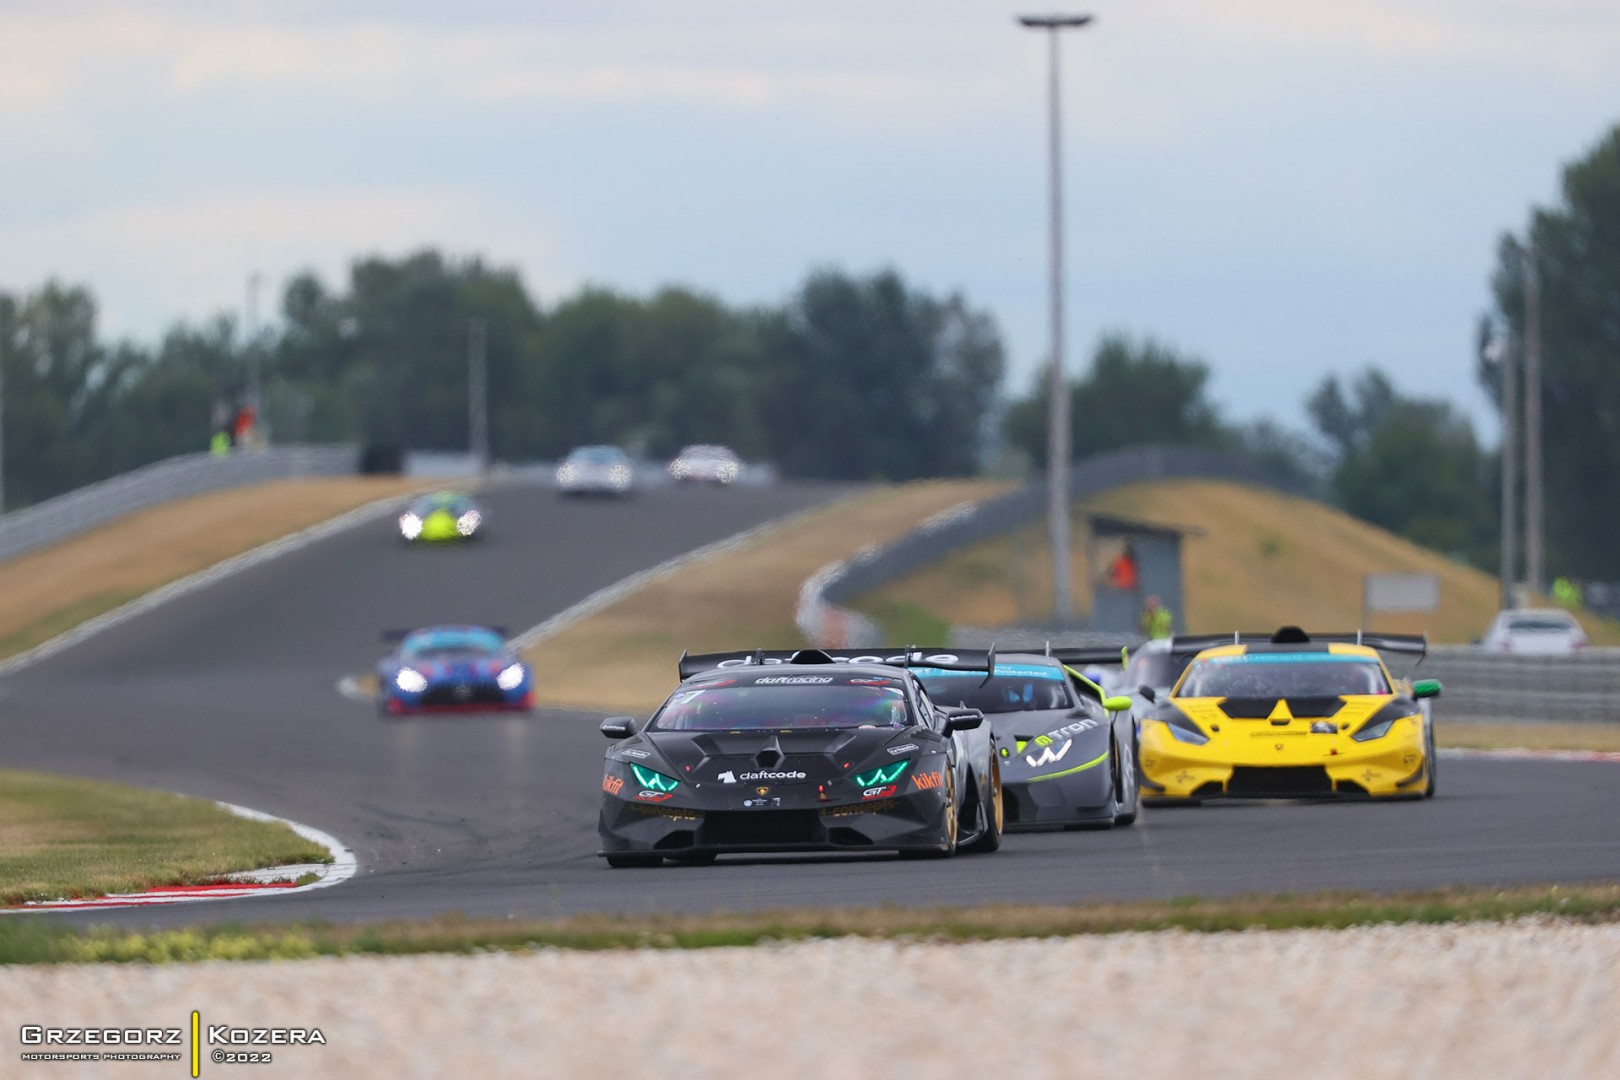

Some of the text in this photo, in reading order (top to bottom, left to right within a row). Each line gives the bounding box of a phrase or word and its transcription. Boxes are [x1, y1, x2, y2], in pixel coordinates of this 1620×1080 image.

[755, 676, 834, 685] daftracing
[739, 770, 807, 780] daftcode
[911, 770, 943, 791] kikfit
